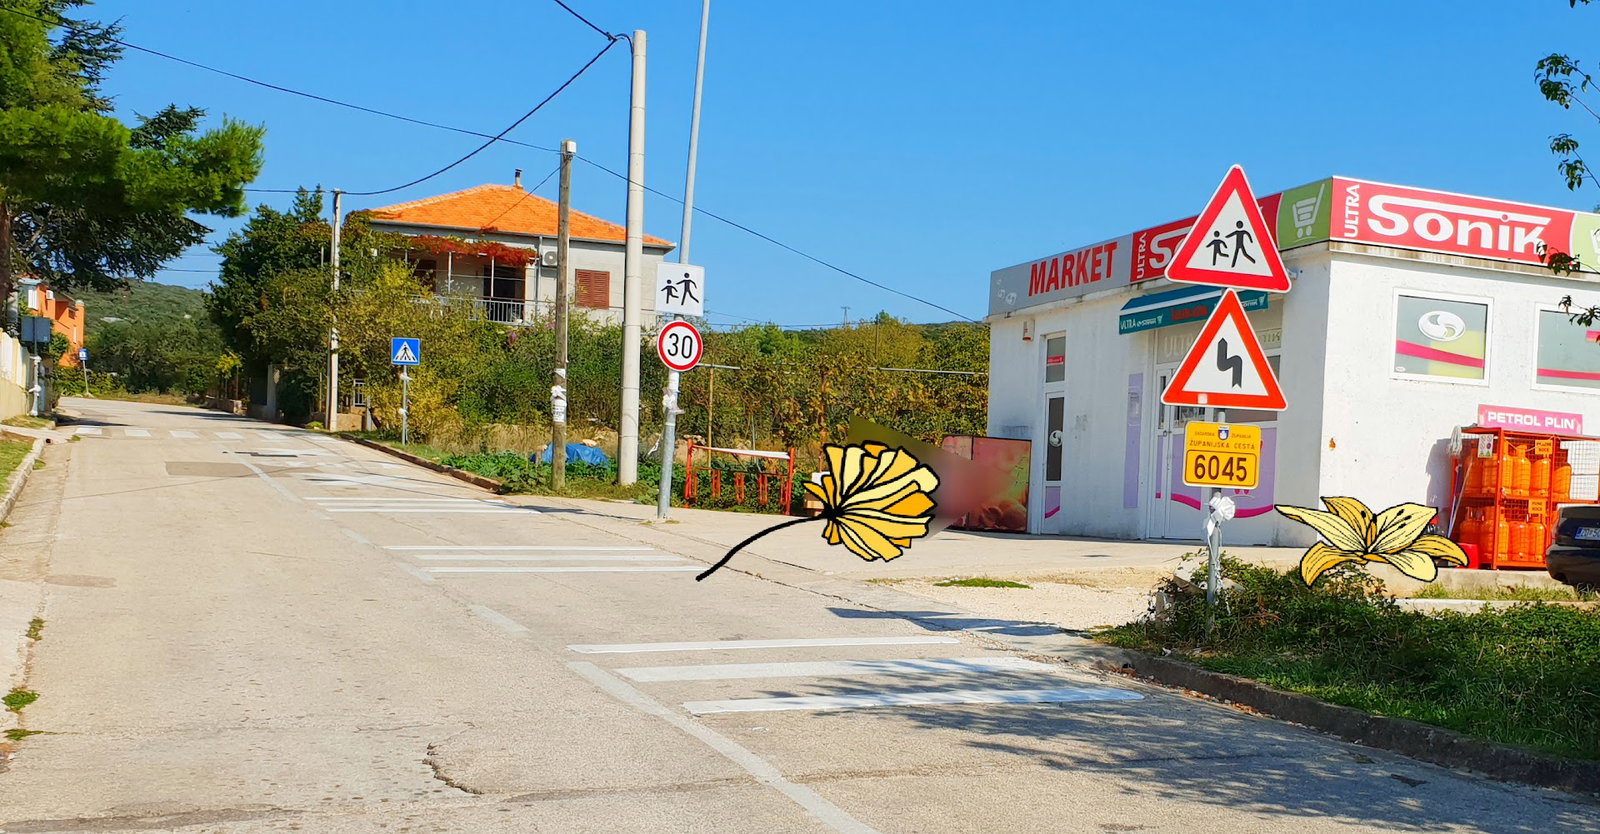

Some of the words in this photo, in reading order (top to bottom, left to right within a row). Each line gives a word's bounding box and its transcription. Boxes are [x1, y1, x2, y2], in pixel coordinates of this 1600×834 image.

[1344, 184, 1360, 238] ULTRA
[1028, 241, 1118, 297] MARKET
[1136, 232, 1147, 279] ULTRA
[667, 332, 693, 359] 30
[1487, 411, 1541, 427] PETROL
[1544, 416, 1575, 429] PLIN
[1233, 442, 1255, 450] CESTA
[1194, 454, 1247, 482] 6045
